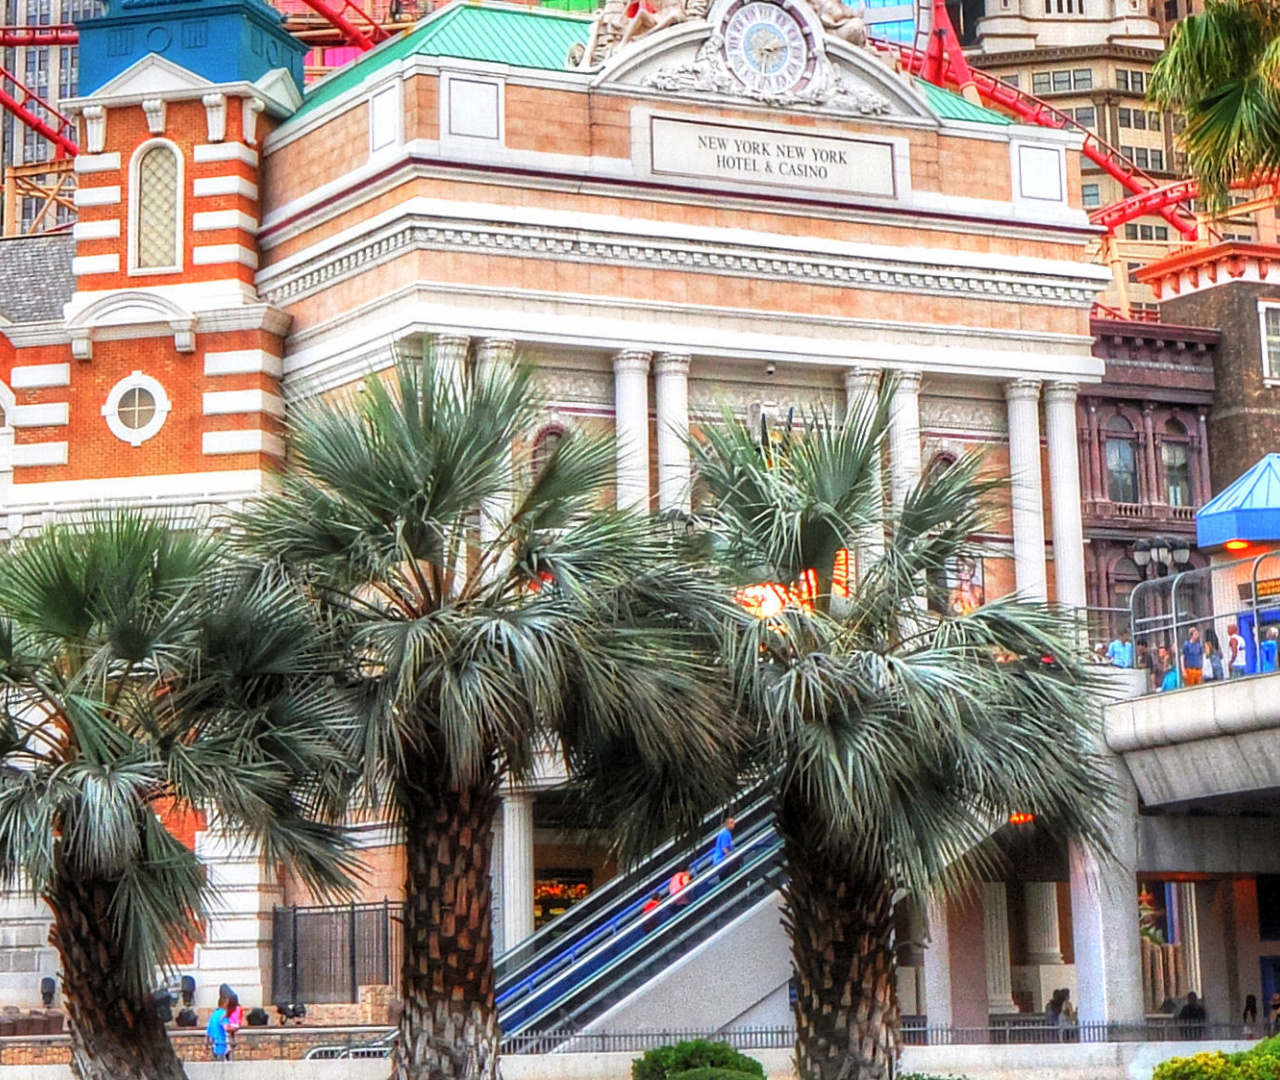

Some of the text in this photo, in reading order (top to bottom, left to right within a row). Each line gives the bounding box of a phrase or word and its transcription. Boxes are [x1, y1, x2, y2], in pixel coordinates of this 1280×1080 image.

[698, 135, 848, 165] NEW YORK NEW YORK
[716, 154, 828, 180] HOTEL & CASINO
